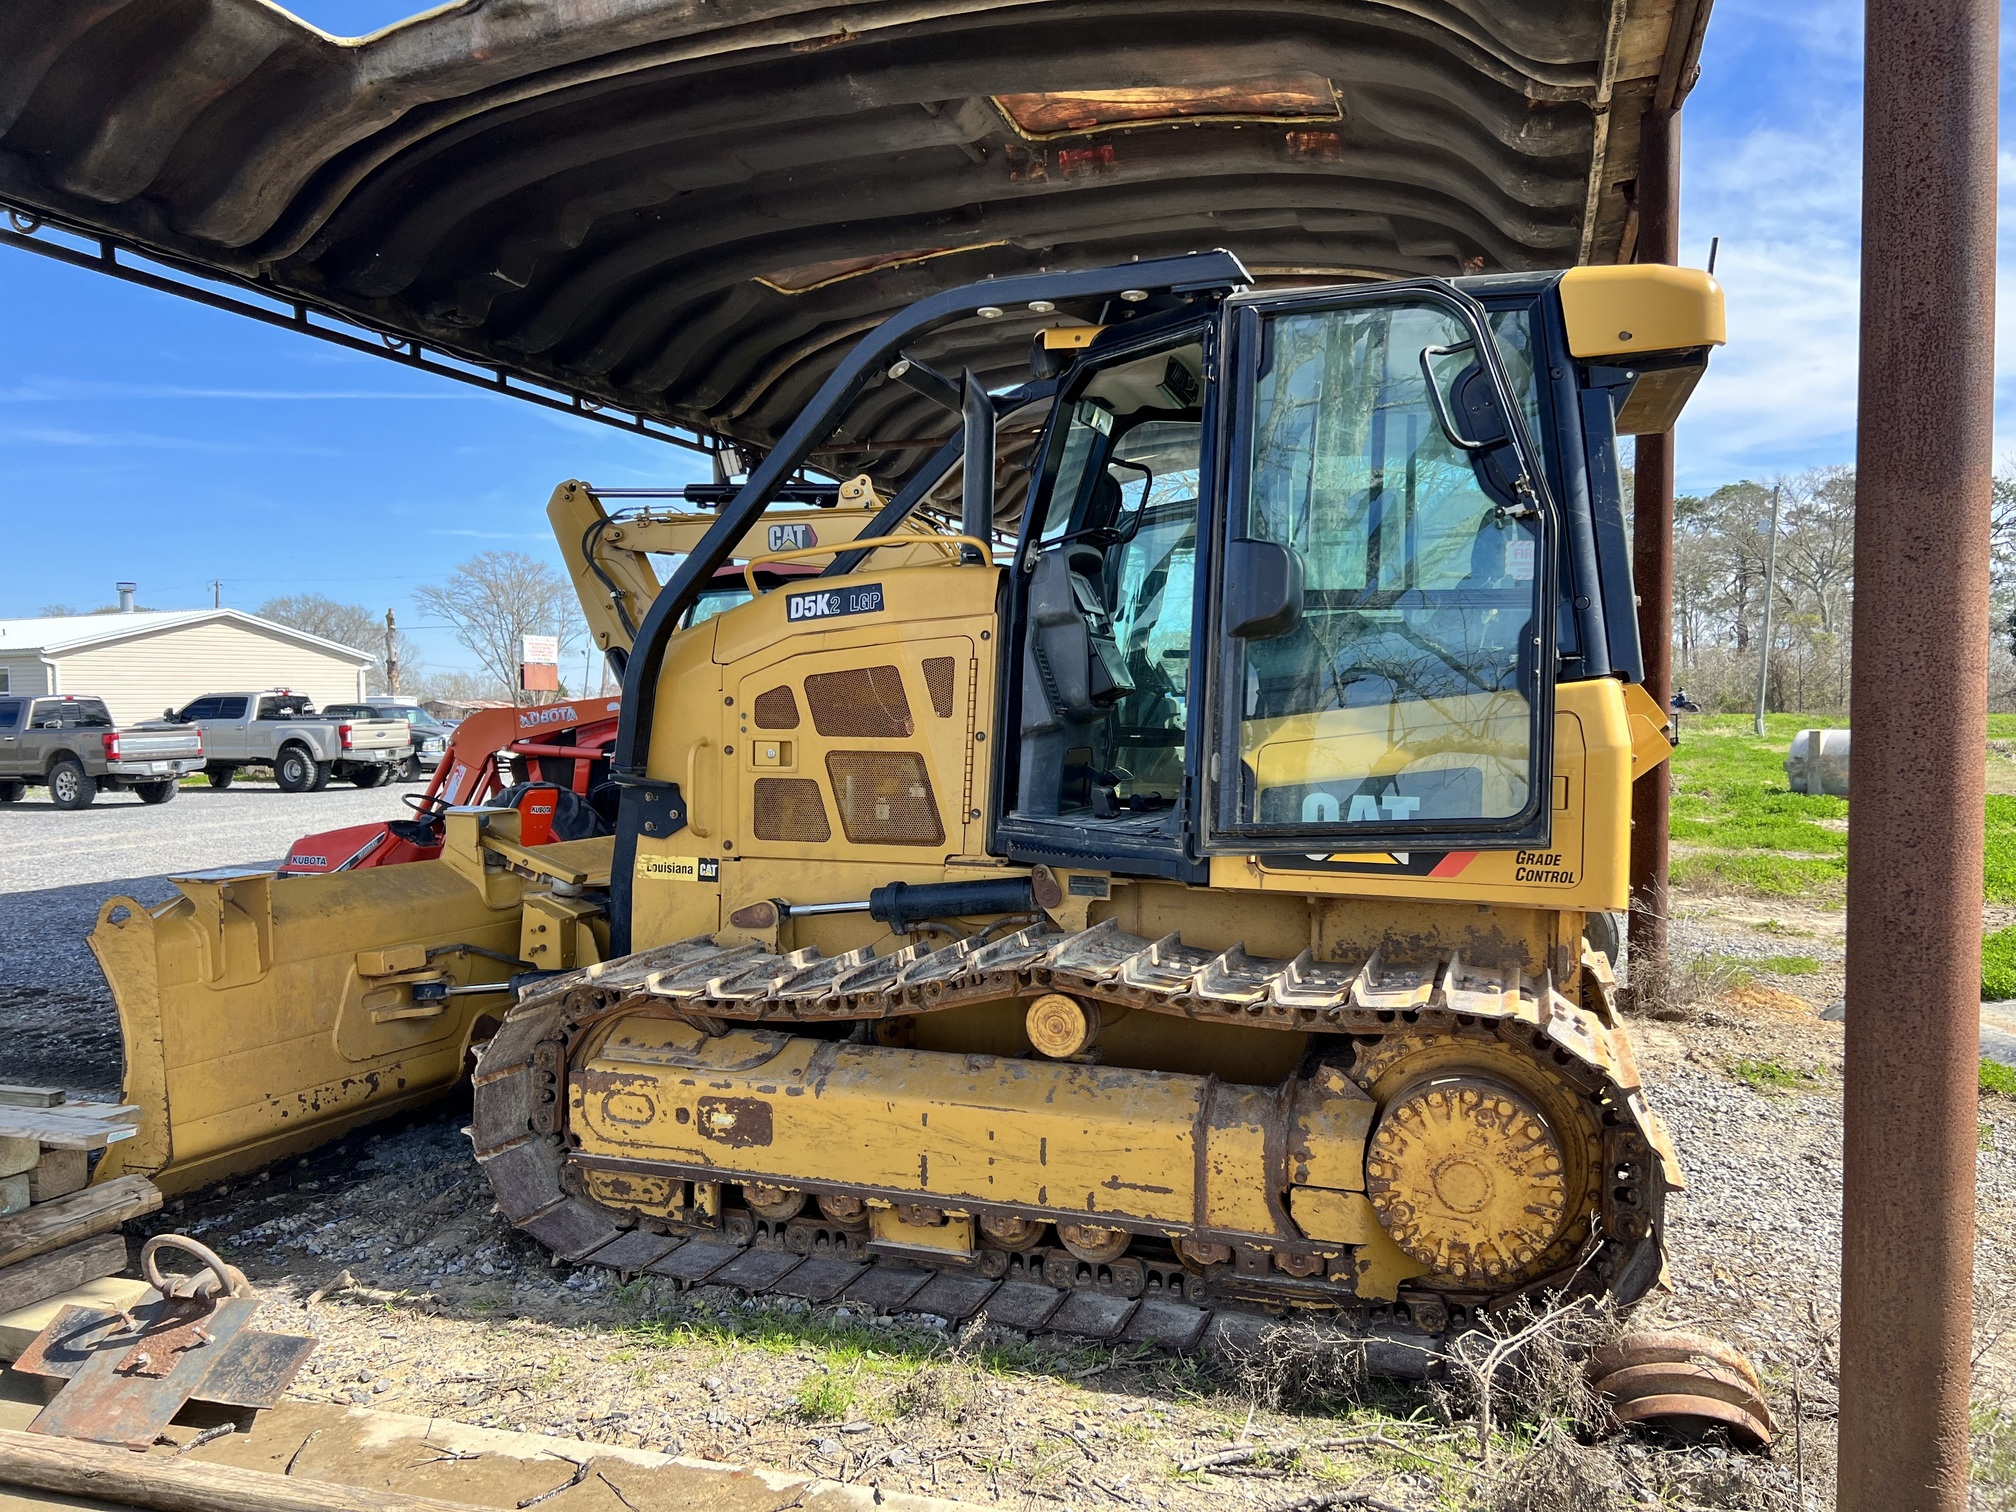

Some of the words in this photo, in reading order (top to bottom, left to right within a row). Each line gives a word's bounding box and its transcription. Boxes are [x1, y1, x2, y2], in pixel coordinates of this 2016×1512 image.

[769, 525, 805, 550] CAT
[1514, 549, 1534, 560] FIR
[790, 593, 841, 619] D5K2
[850, 592, 881, 612] LGP
[292, 856, 326, 866] KUBOTA
[1516, 850, 1562, 866] GRADE
[700, 863, 717, 877] CAT
[1515, 867, 1575, 884] CONTROL
